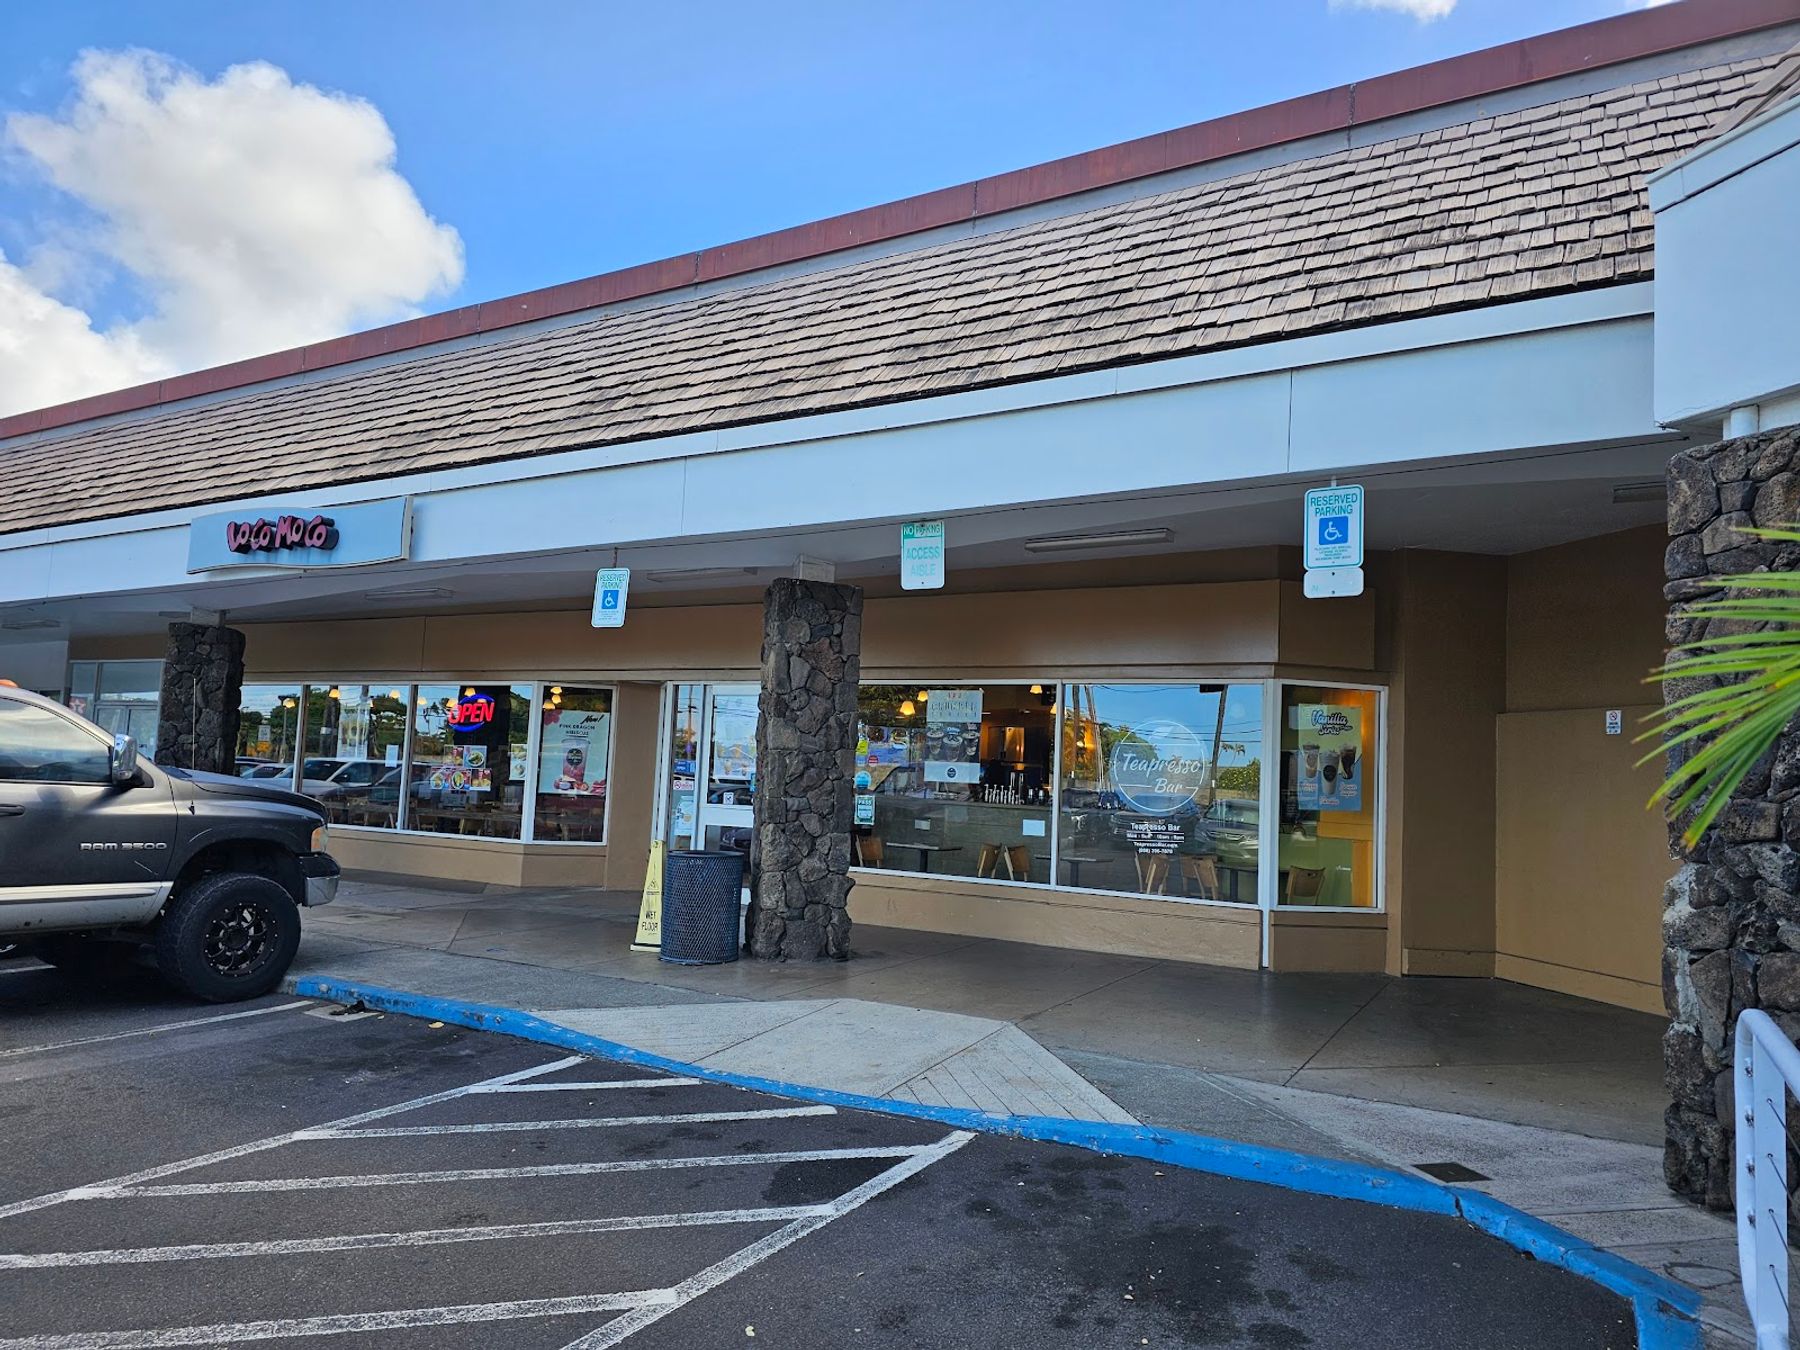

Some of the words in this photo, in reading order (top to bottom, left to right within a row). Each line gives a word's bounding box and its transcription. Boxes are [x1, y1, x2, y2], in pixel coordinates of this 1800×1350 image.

[1310, 492, 1358, 507] RESERVED
[1315, 504, 1353, 517] PARKING
[903, 525, 914, 535] NO
[905, 546, 940, 560] ACCESS
[911, 563, 936, 576] AISLE
[448, 702, 494, 724] OPEN
[1311, 709, 1348, 726] Vanilla
[1123, 752, 1201, 779] Teapresso
[1154, 778, 1183, 794] Bar
[1130, 822, 1166, 832] Teapresso
[1167, 823, 1181, 831] Bar
[80, 842, 119, 850] RAM
[641, 921, 659, 931] FLOOR
